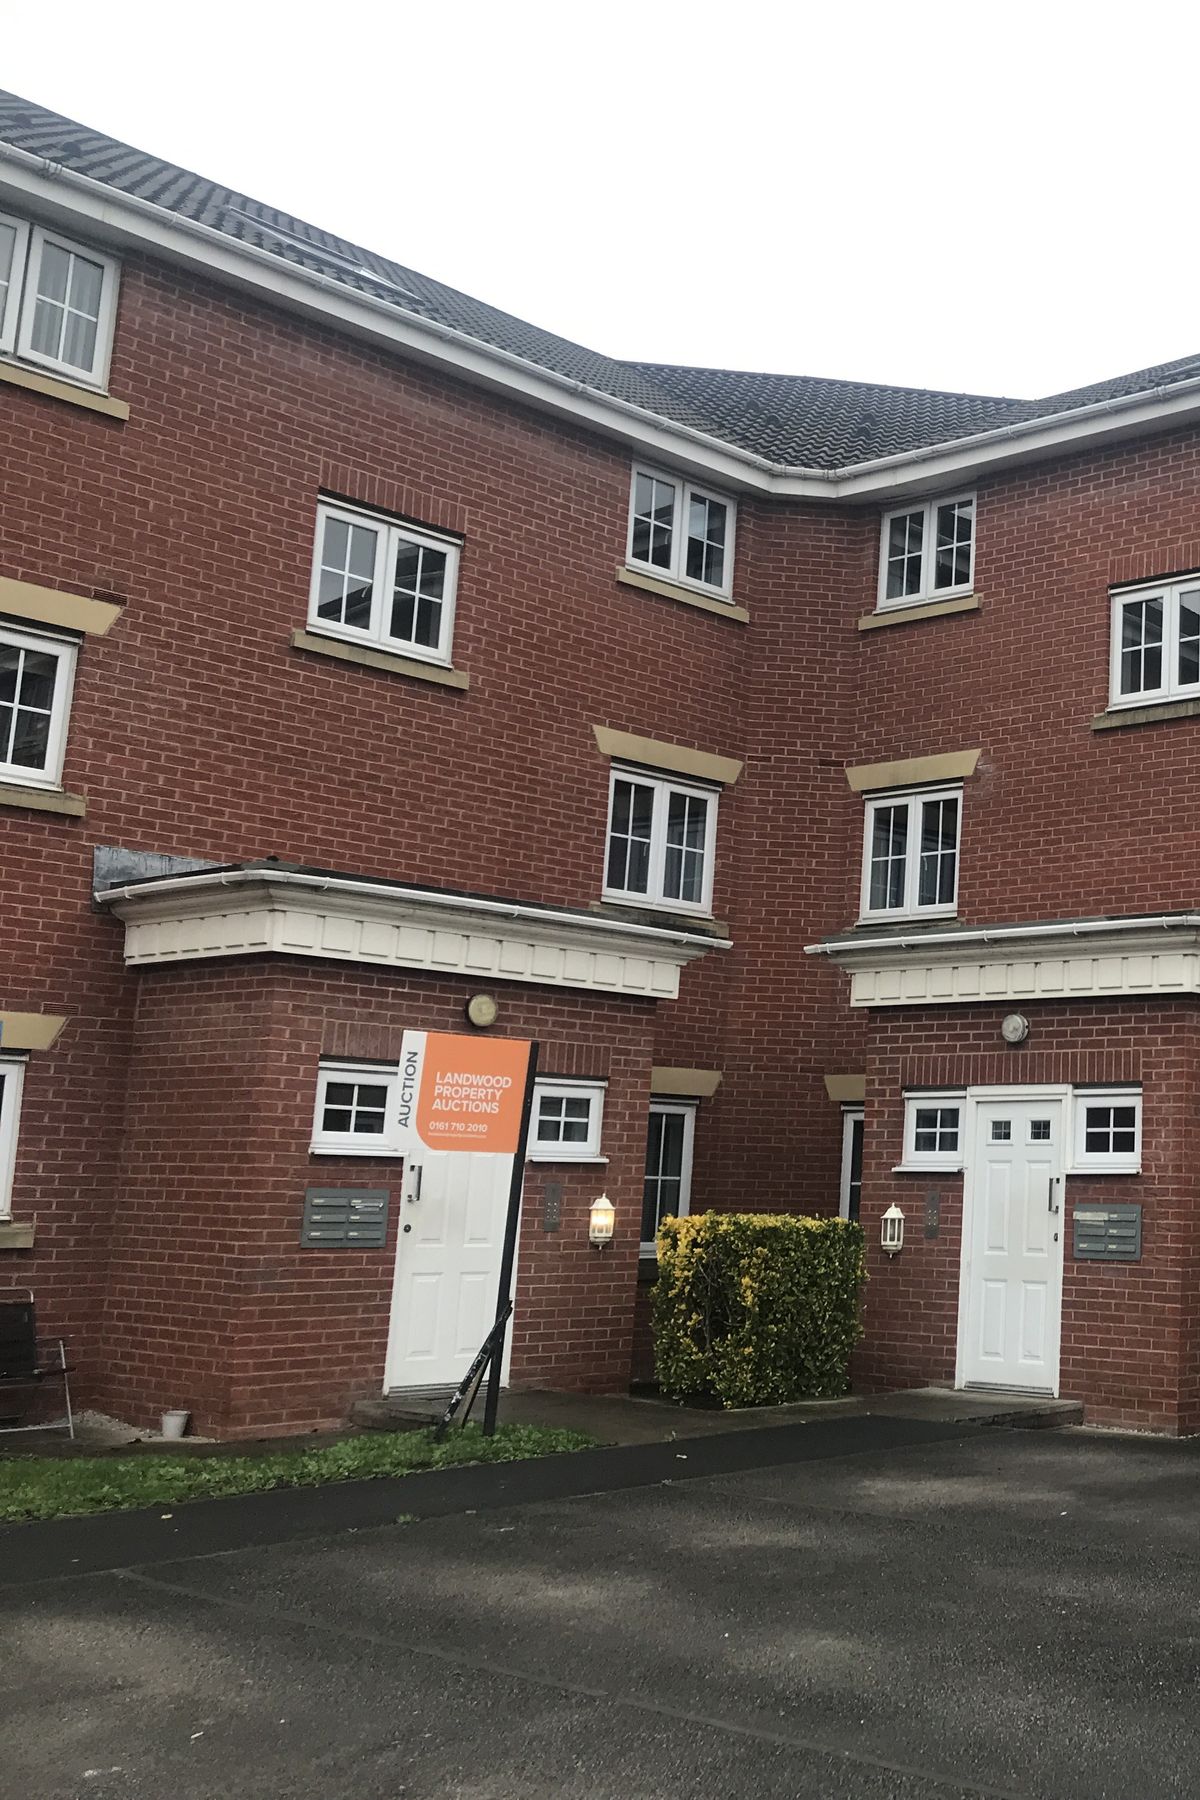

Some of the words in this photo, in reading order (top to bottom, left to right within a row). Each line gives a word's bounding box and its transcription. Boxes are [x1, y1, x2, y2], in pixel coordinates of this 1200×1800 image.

[435, 1072, 512, 1088] LANDWOOD
[397, 1051, 419, 1128] AUCTION
[433, 1085, 503, 1101] PROPERTY
[431, 1098, 500, 1114] AUCTIONS
[428, 1121, 449, 1130] 0161
[450, 1122, 465, 1131] 710
[466, 1123, 488, 1132] 2010
